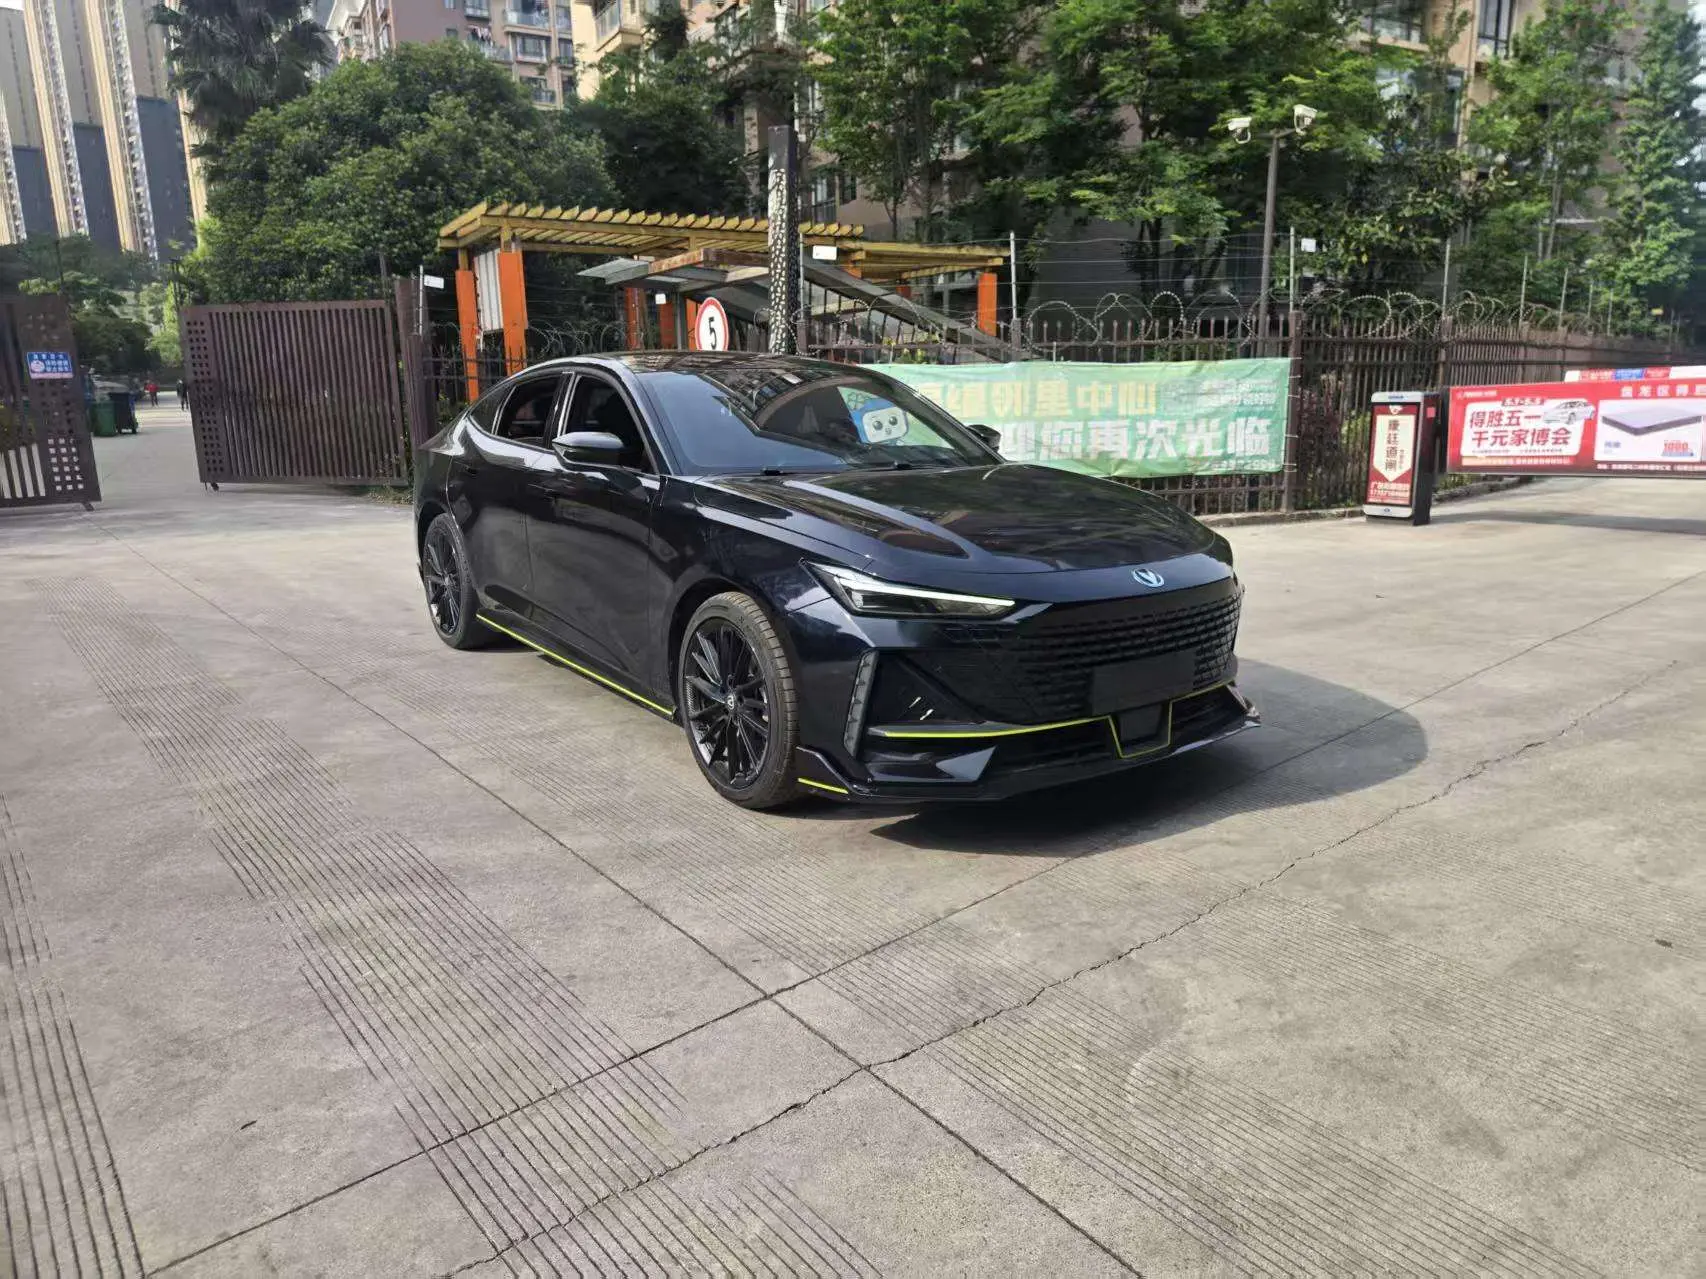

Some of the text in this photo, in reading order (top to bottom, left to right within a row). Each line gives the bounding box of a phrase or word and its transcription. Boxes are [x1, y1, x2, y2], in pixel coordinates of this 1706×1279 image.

[708, 316, 717, 350] 5
[1470, 410, 1541, 428] 得胜五一
[1471, 427, 1572, 447] 千元家博会
